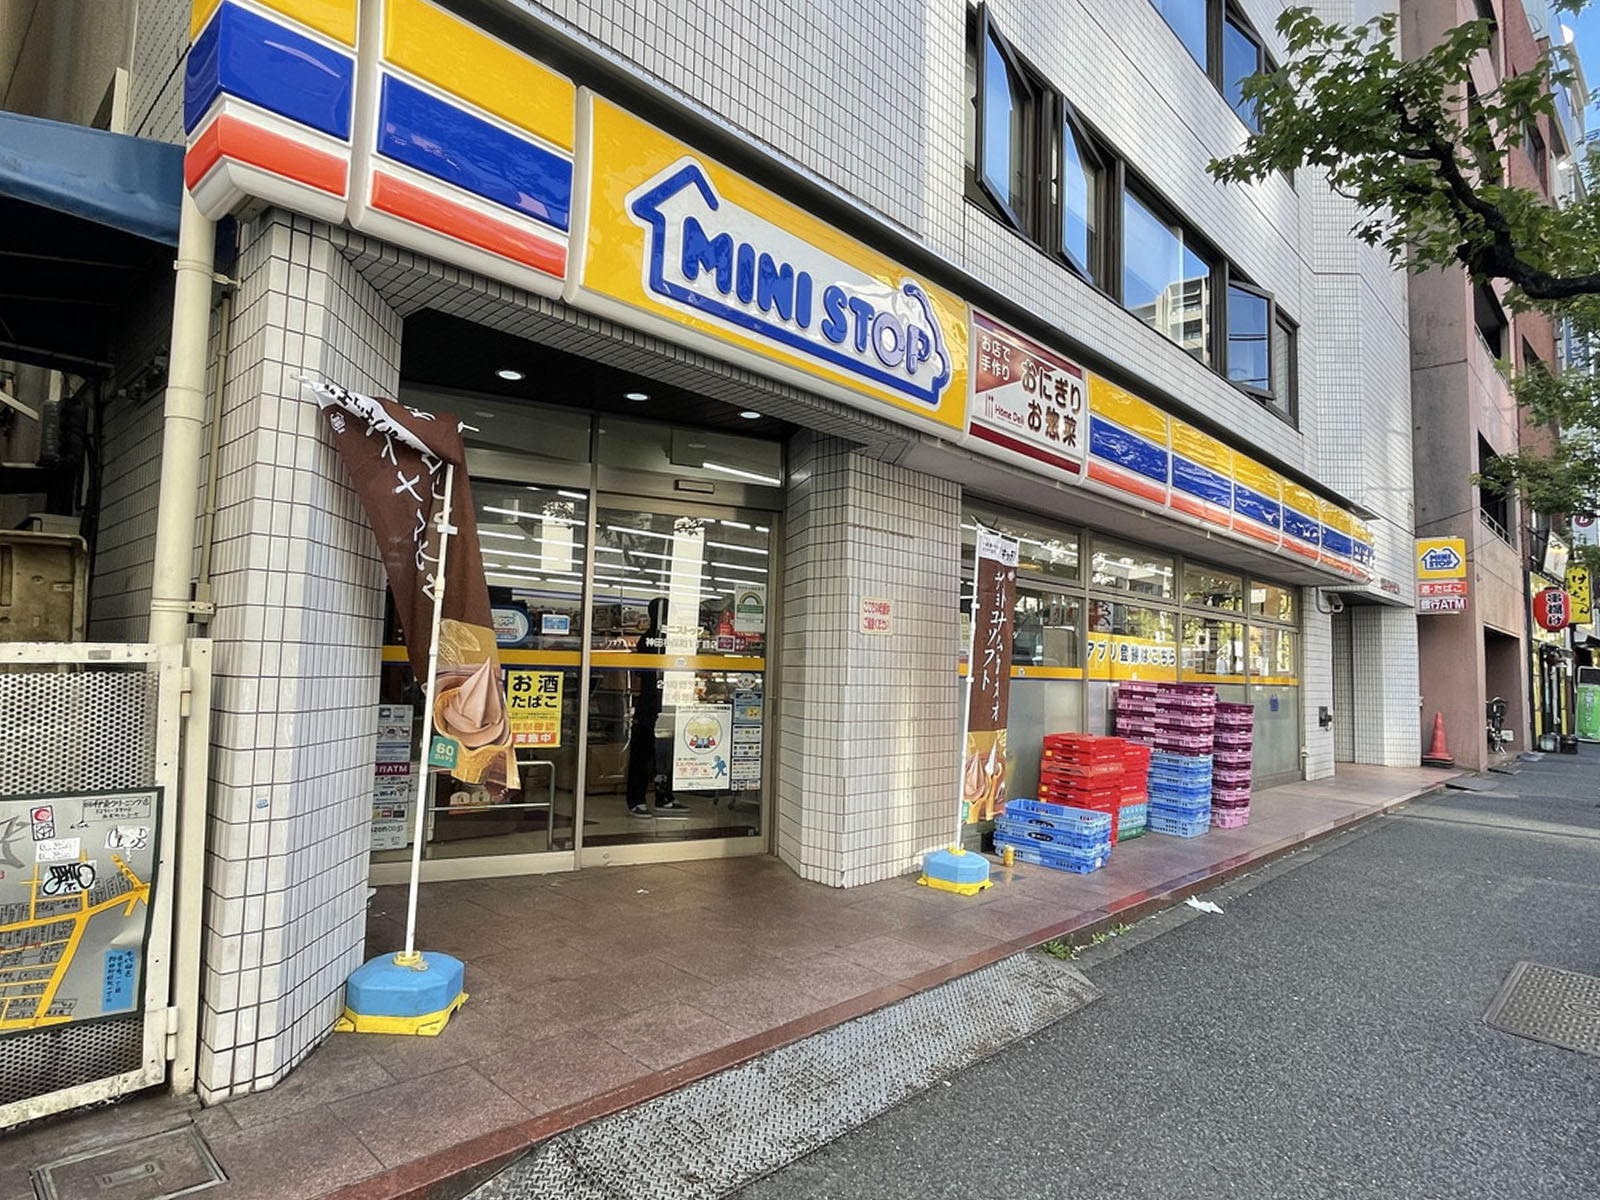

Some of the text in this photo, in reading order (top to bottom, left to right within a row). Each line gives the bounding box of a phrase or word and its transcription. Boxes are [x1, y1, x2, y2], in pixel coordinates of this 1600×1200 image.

[681, 218, 932, 376] MINI STOP
[980, 335, 1012, 363] お店で
[980, 355, 1011, 382] 手作り
[1020, 357, 1082, 415] おにぎり
[994, 402, 1025, 426] Home Deli
[1027, 399, 1078, 448] お惣菜
[1429, 553, 1452, 561] MINI
[1429, 560, 1454, 568] STOP
[512, 674, 560, 693] お酒
[511, 695, 558, 709] たばこ
[436, 742, 454, 757] 60
[377, 763, 409, 773] 行ATM
